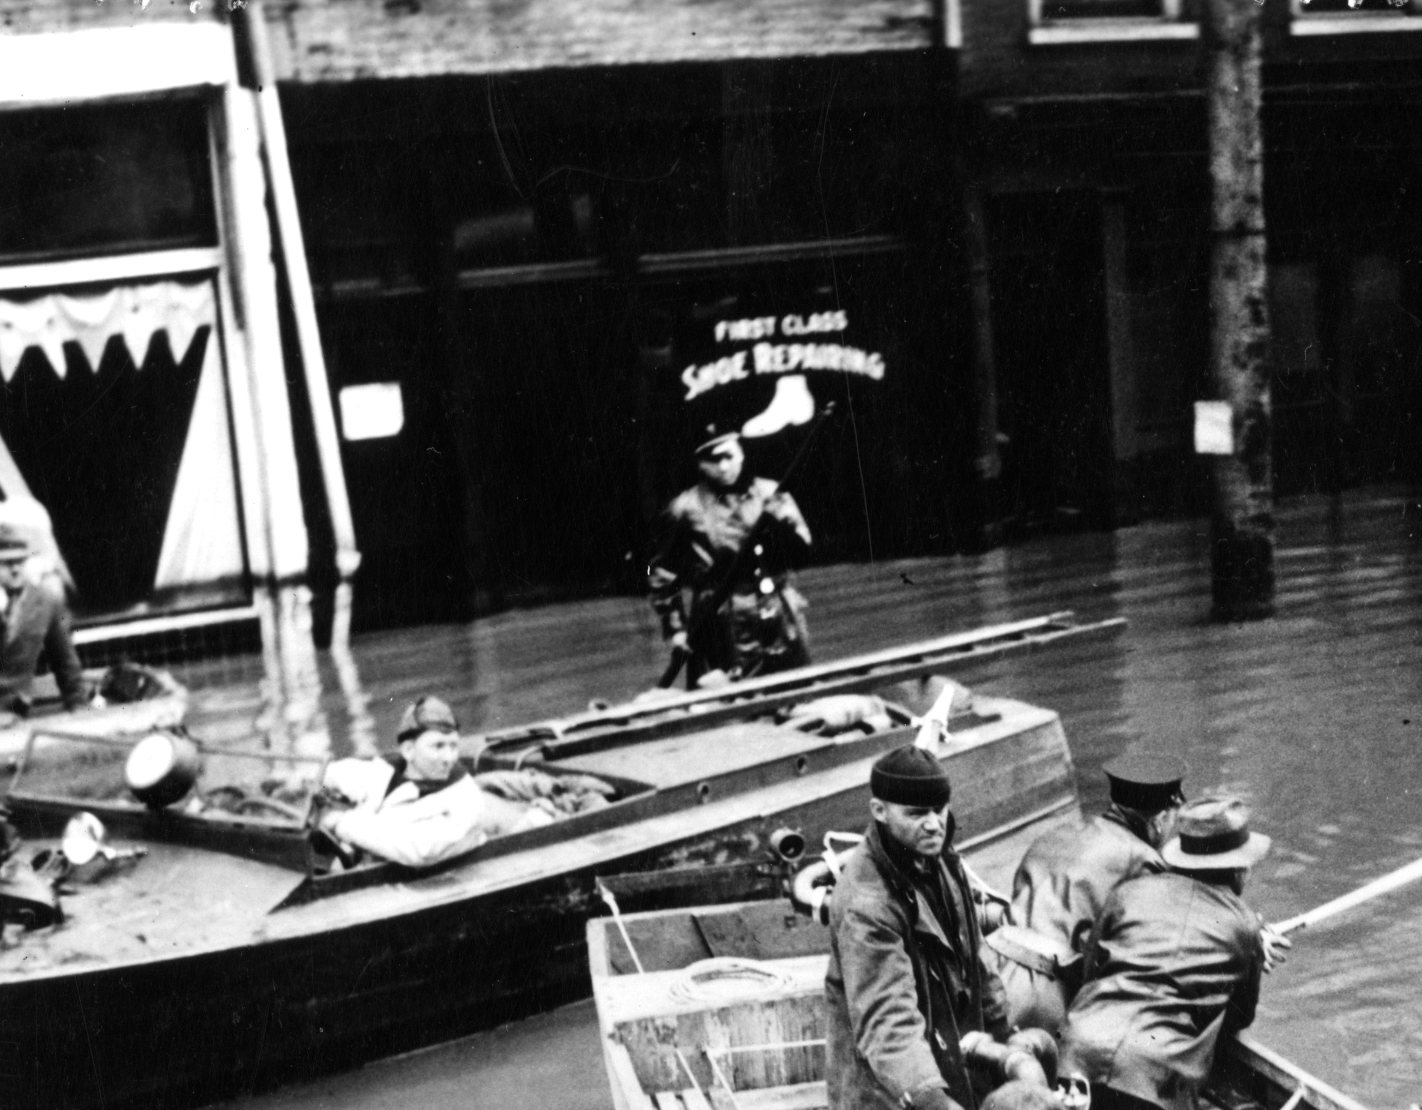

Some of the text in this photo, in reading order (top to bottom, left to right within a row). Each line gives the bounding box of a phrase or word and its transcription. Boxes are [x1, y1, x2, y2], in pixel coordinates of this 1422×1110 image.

[714, 310, 848, 342] FIRST CLASS
[681, 342, 885, 401] SHOE REPAIRING
